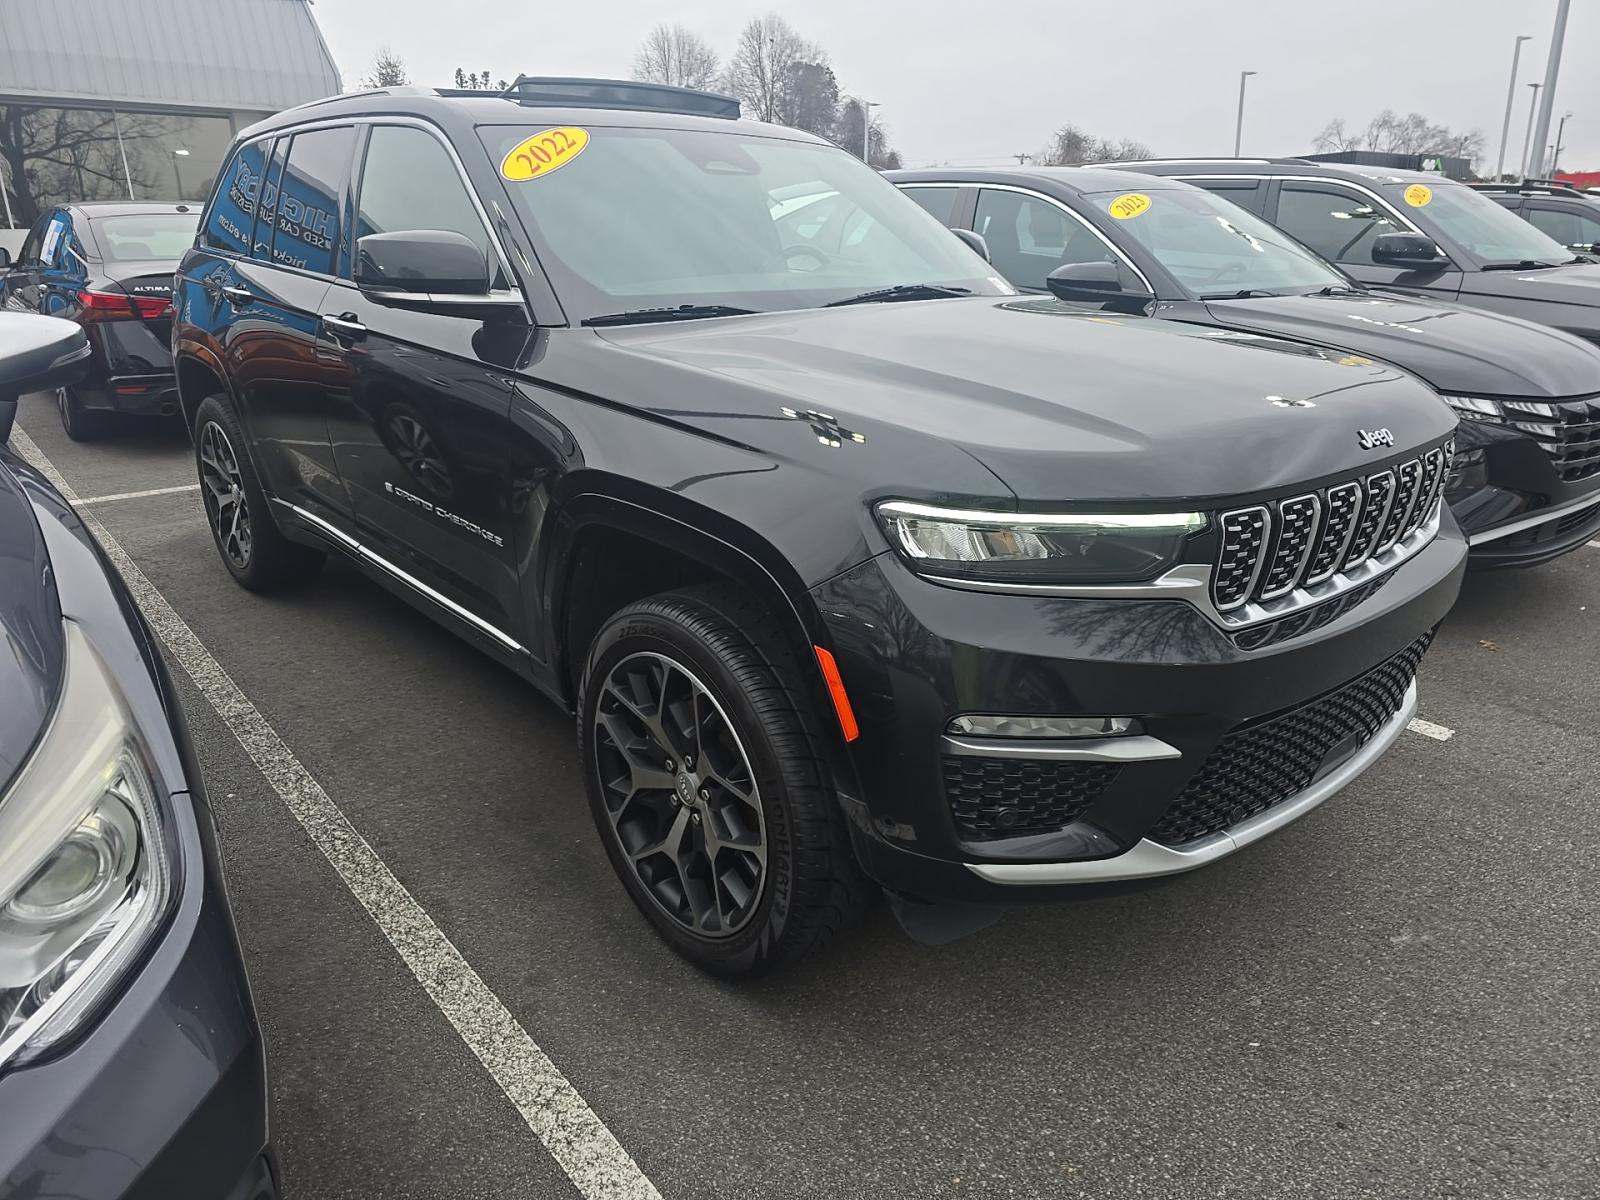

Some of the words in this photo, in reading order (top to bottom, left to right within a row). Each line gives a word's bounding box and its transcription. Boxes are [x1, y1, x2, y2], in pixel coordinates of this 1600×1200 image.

[516, 131, 577, 174] 2022
[1115, 195, 1146, 217] 2023
[1357, 428, 1394, 450] Jeep
[435, 507, 504, 547] CHEROKEE
